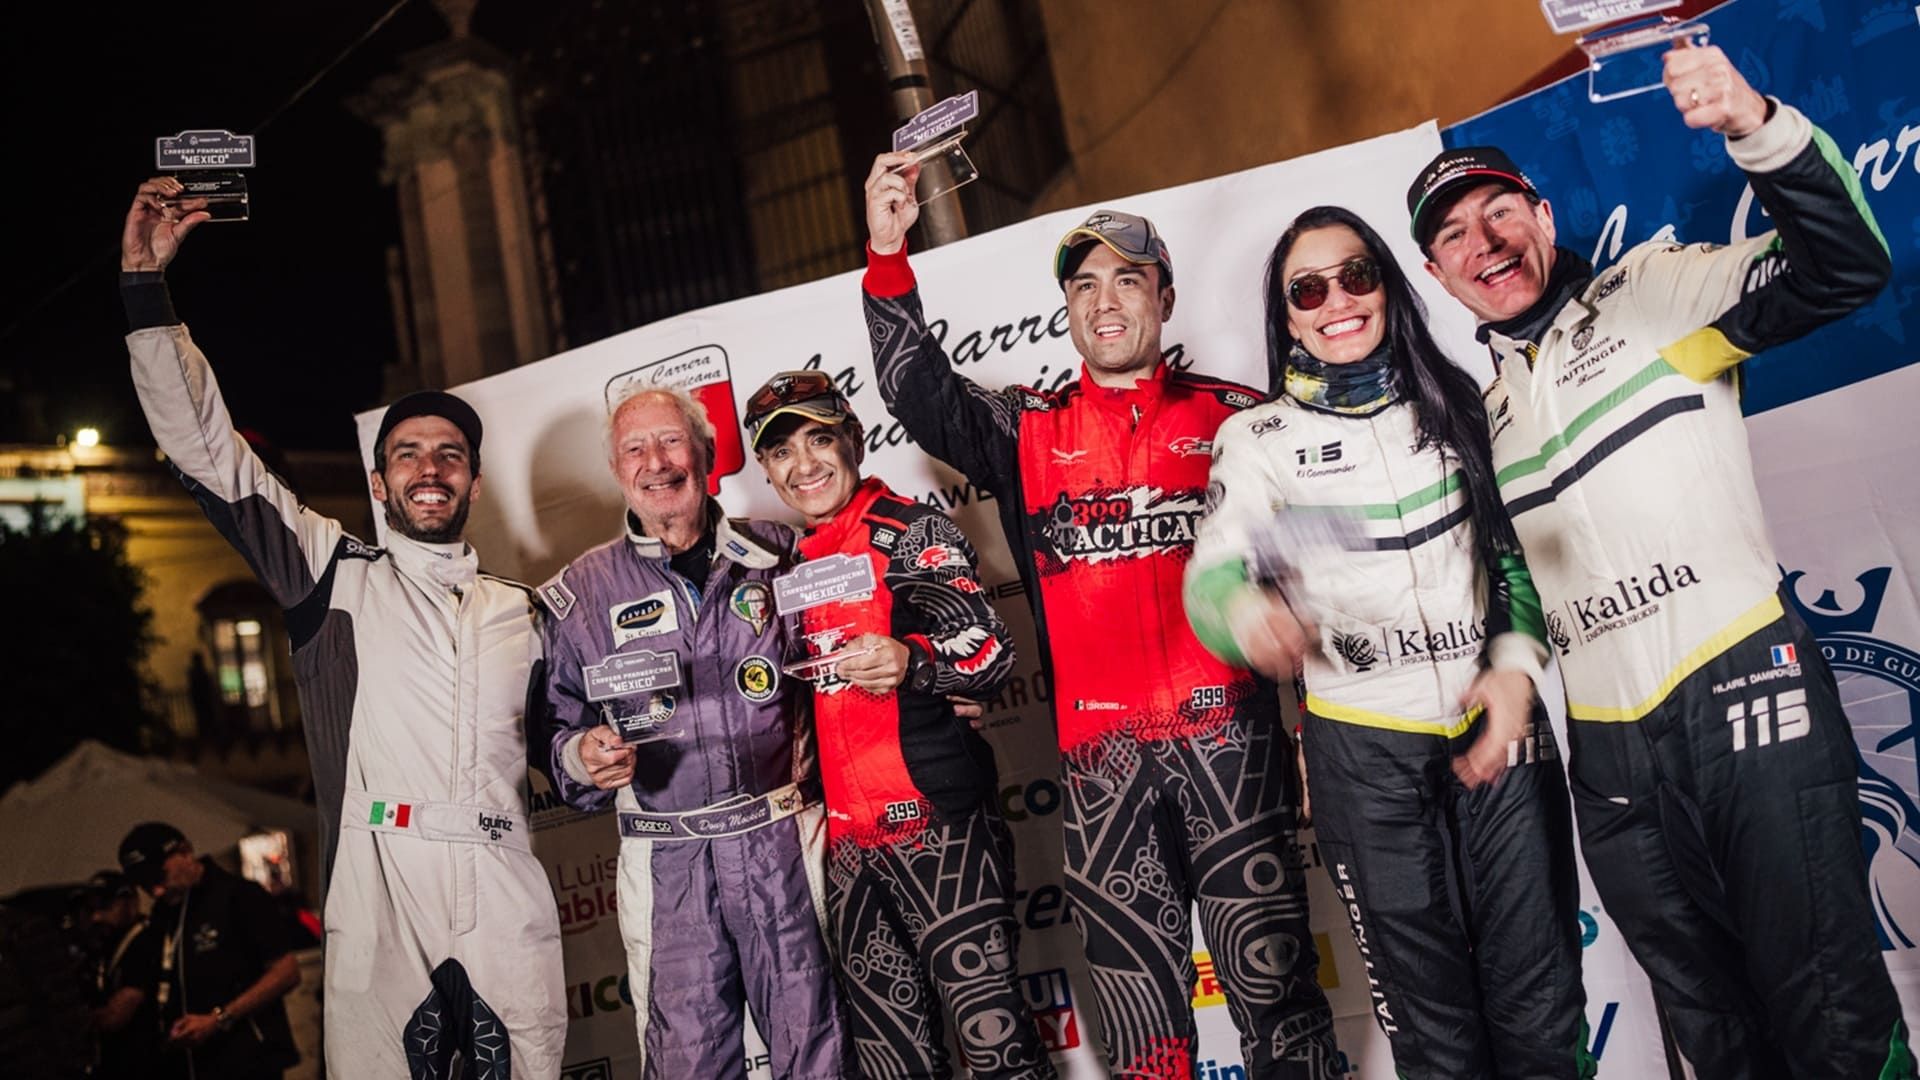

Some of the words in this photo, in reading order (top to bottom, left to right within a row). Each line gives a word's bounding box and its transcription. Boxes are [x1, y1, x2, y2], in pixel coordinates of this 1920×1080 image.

[1555, 339, 1628, 388] TAITTINGER
[1251, 416, 1286, 435] OMP
[1296, 440, 1343, 465] 115
[1072, 502, 1128, 527] 399
[1573, 562, 1701, 632] Kalida
[1845, 646, 1876, 665] DE
[1191, 687, 1225, 709] 399
[1727, 688, 1811, 753] 115
[478, 812, 513, 832] Iguiniz
[886, 801, 919, 821] 399
[699, 818, 725, 832] Doug
